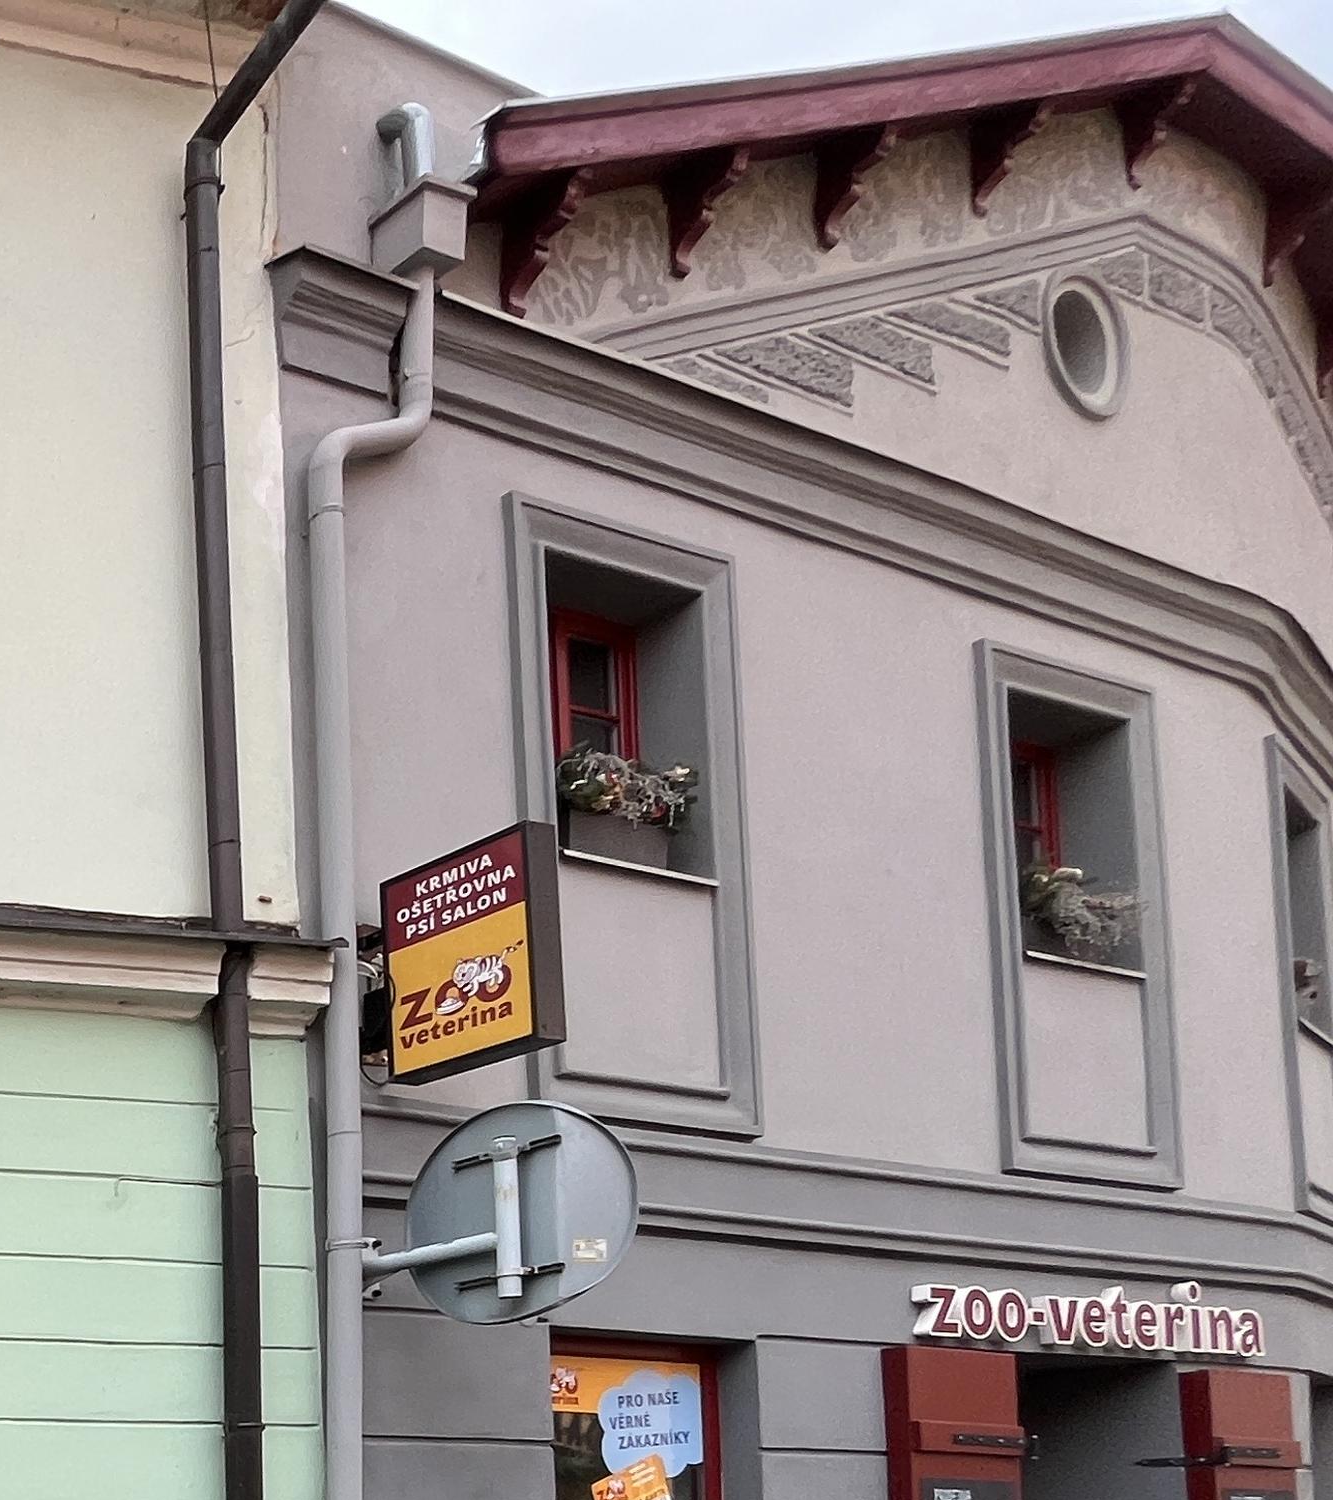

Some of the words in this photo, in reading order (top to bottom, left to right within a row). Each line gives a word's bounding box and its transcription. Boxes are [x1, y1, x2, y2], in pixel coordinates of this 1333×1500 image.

[396, 864, 516, 924] OŠETŘOVNA
[415, 853, 493, 897] KRMIVA
[406, 913, 435, 940] PSÍ
[441, 887, 507, 926] SALON
[400, 1000, 513, 1049] veterina
[609, 1411, 651, 1430] VĚRNÉ
[617, 1393, 643, 1409] PRO
[648, 1389, 680, 1406] NAŠE
[617, 1428, 692, 1450] ZÁKAZNÍKY
